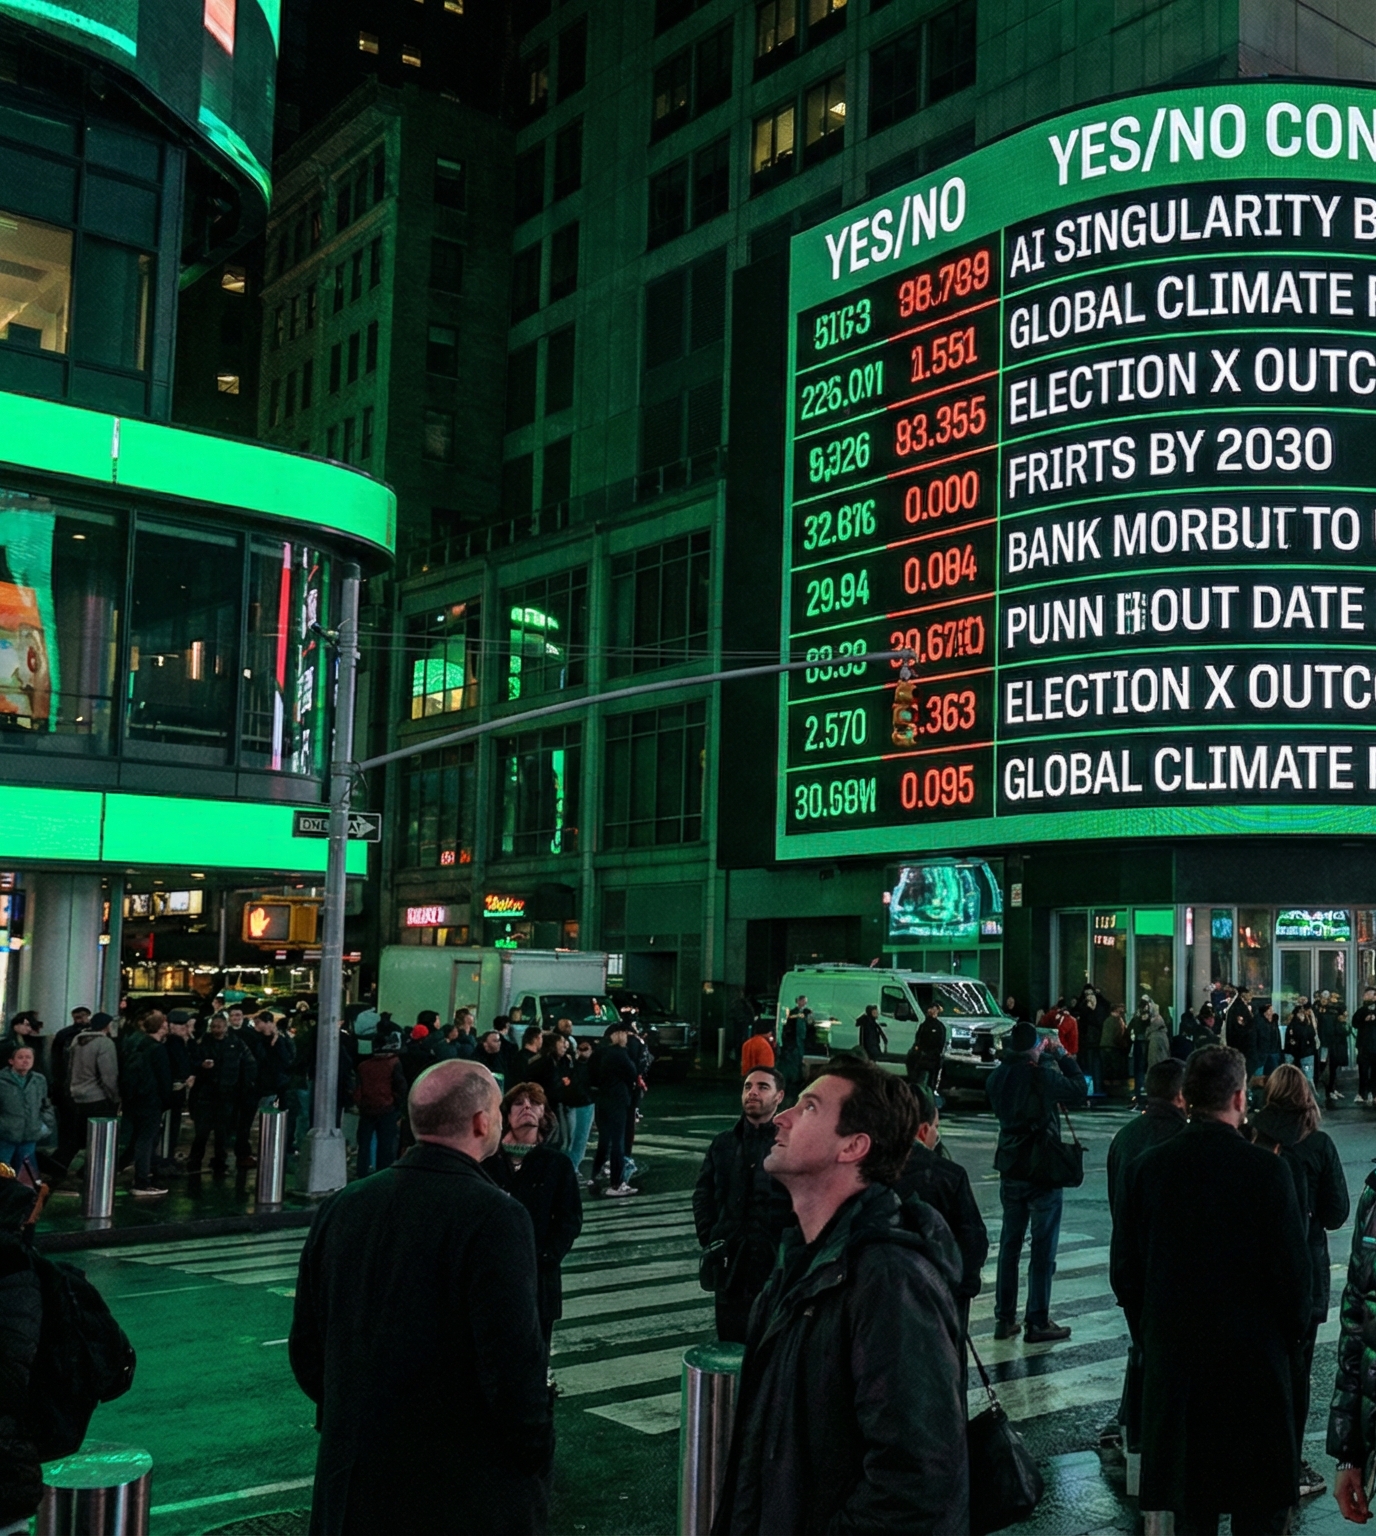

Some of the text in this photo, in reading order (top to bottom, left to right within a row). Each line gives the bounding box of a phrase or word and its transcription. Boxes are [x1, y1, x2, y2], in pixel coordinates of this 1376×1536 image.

[1048, 103, 1247, 186] YES/NO
[824, 176, 966, 280] YES/NO
[1009, 228, 1046, 278] AI
[1054, 194, 1341, 263] SINGULARITY
[1009, 281, 1146, 349] GLOBAL
[1157, 270, 1354, 320] CLIMATE
[1010, 351, 1196, 425] ELECTION
[1210, 348, 1242, 393] X
[1008, 426, 1333, 499] FRIRTS BY 2030
[904, 469, 979, 524] 0.000
[1008, 517, 1102, 573] BANK
[1302, 506, 1360, 551] TO
[806, 568, 870, 617] 29.94
[1007, 594, 1103, 649] PUNN
[1253, 585, 1365, 630] DATE
[1006, 666, 1190, 724] ELECTION
[1204, 664, 1236, 710] X
[804, 707, 867, 752] 2.570
[901, 764, 975, 810] 0.095
[1004, 749, 1143, 801] GLOBAL
[1154, 745, 1354, 792] CLIMATE
